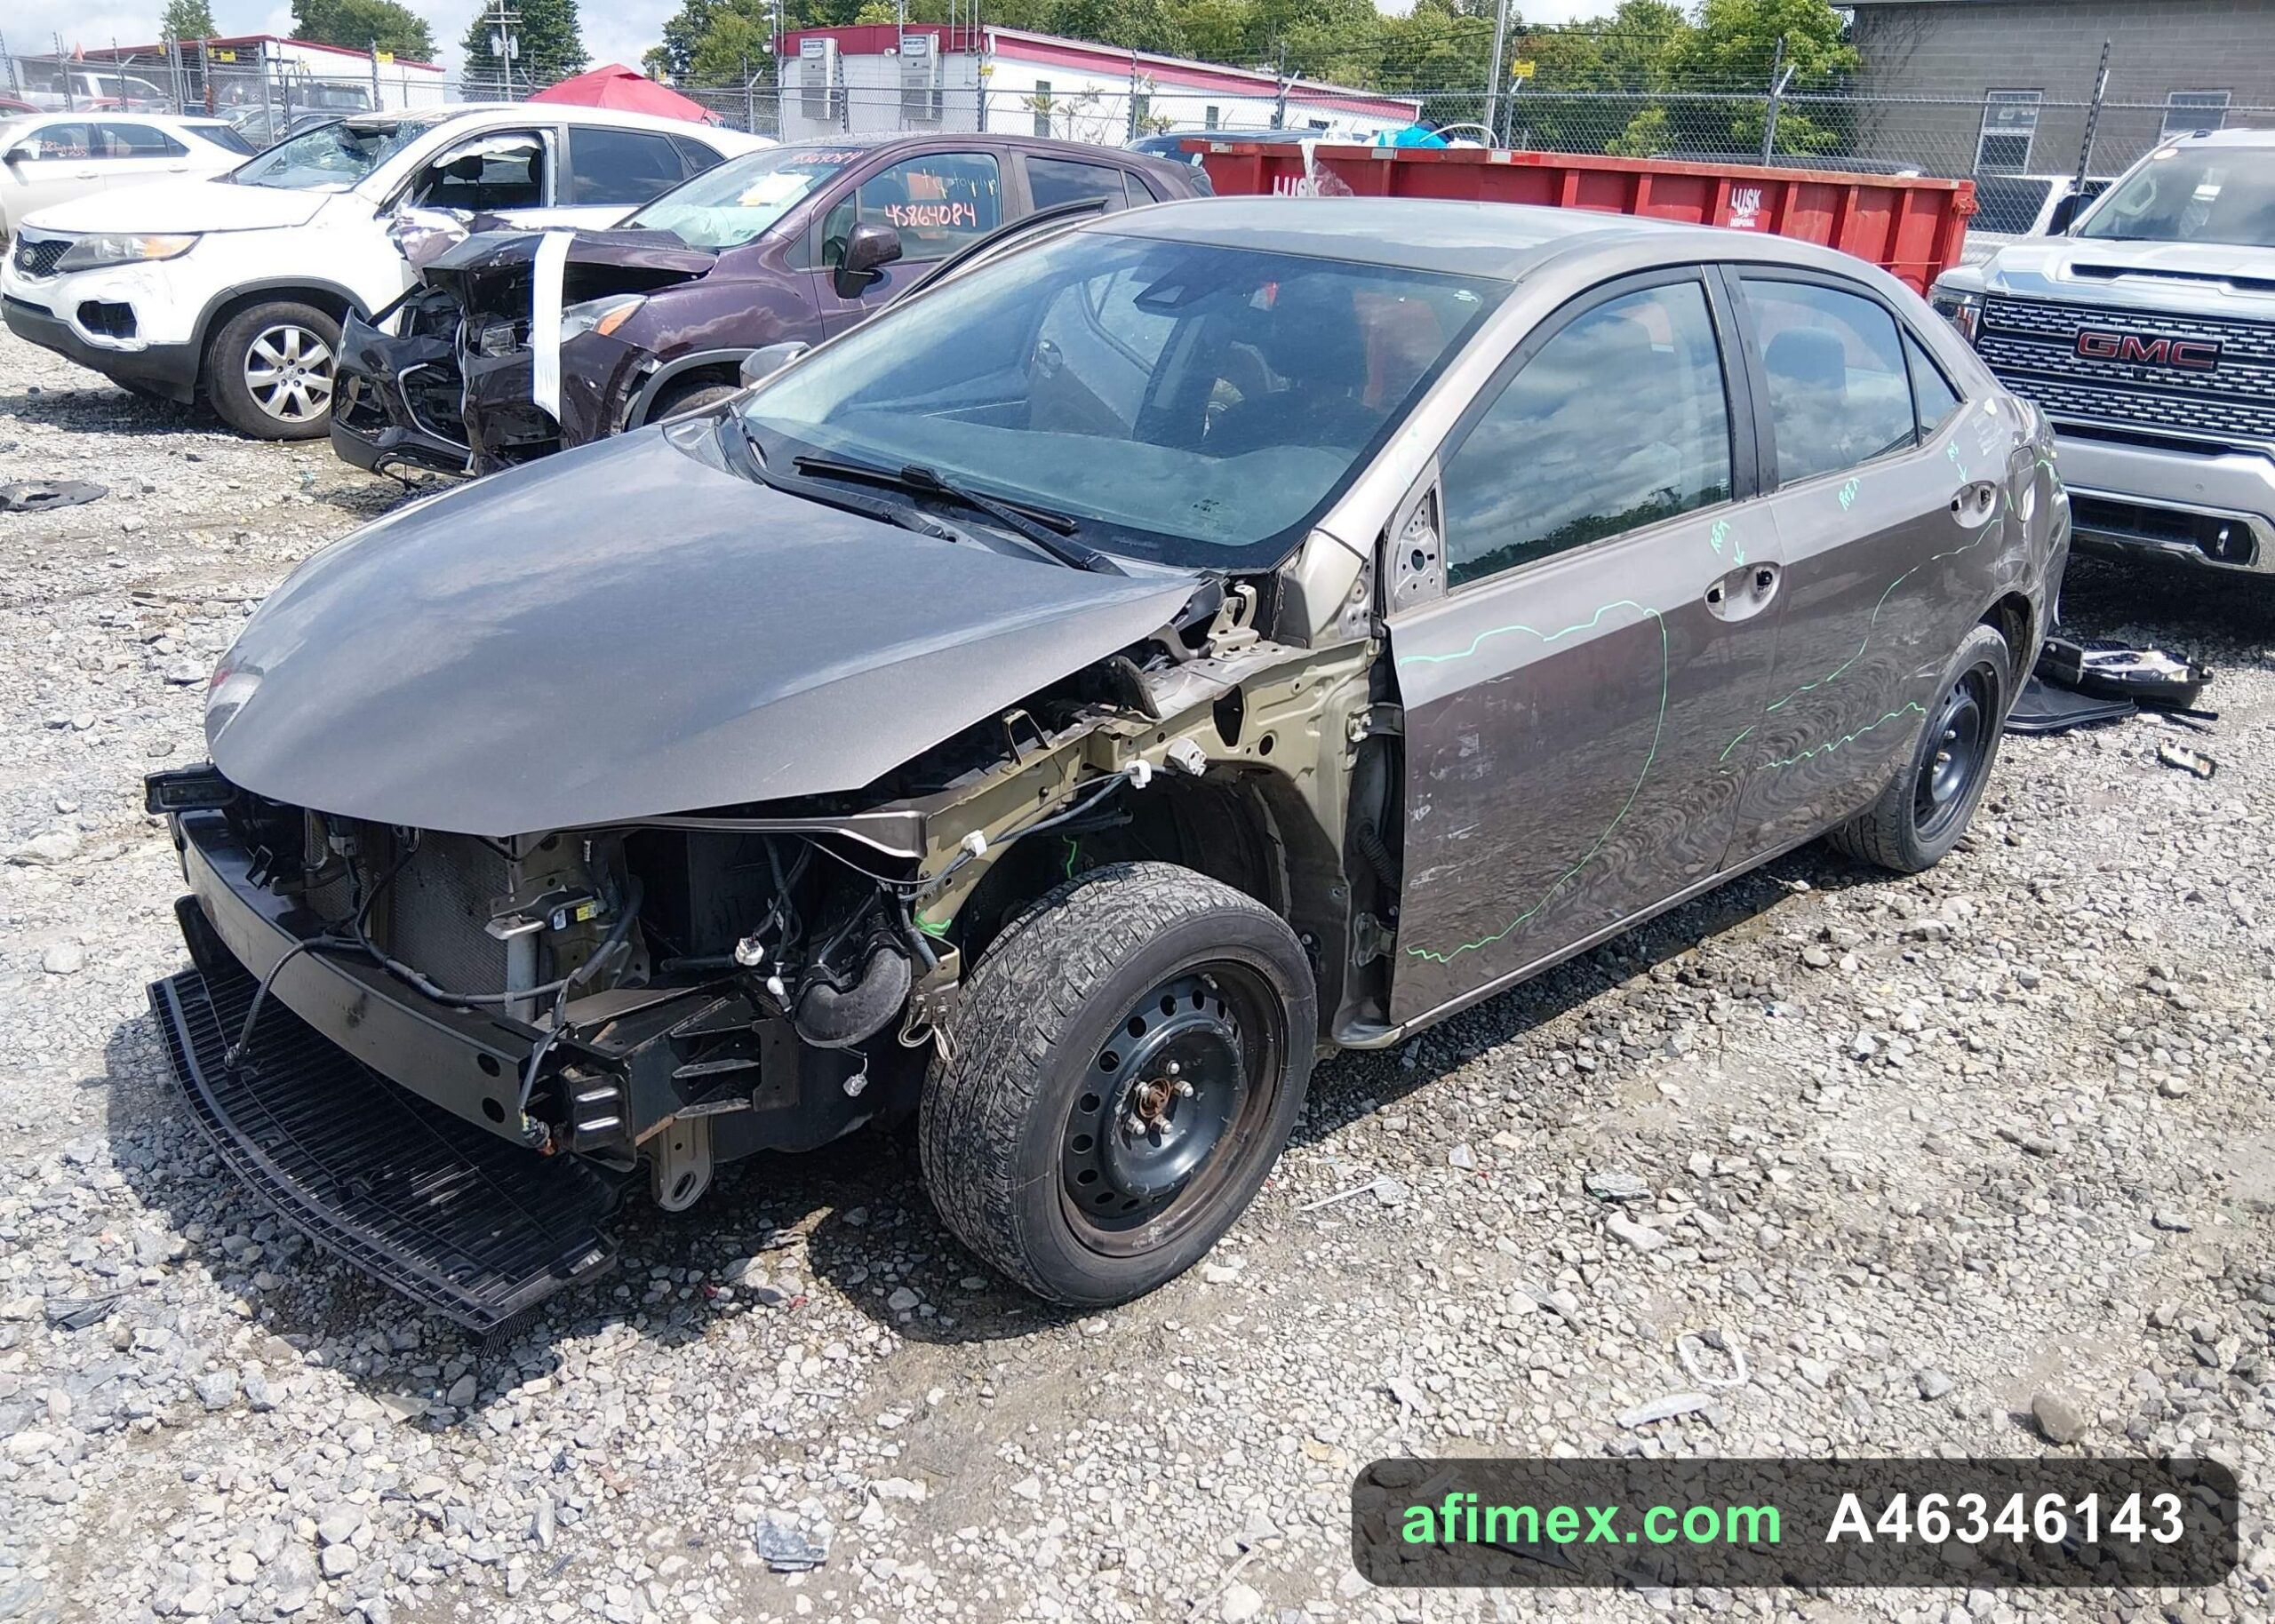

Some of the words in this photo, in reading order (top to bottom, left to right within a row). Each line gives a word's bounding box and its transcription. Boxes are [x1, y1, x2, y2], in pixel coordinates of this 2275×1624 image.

[884, 202, 977, 228] 45864084
[1731, 187, 1762, 215] LUSK
[2078, 331, 2218, 369] GMC
